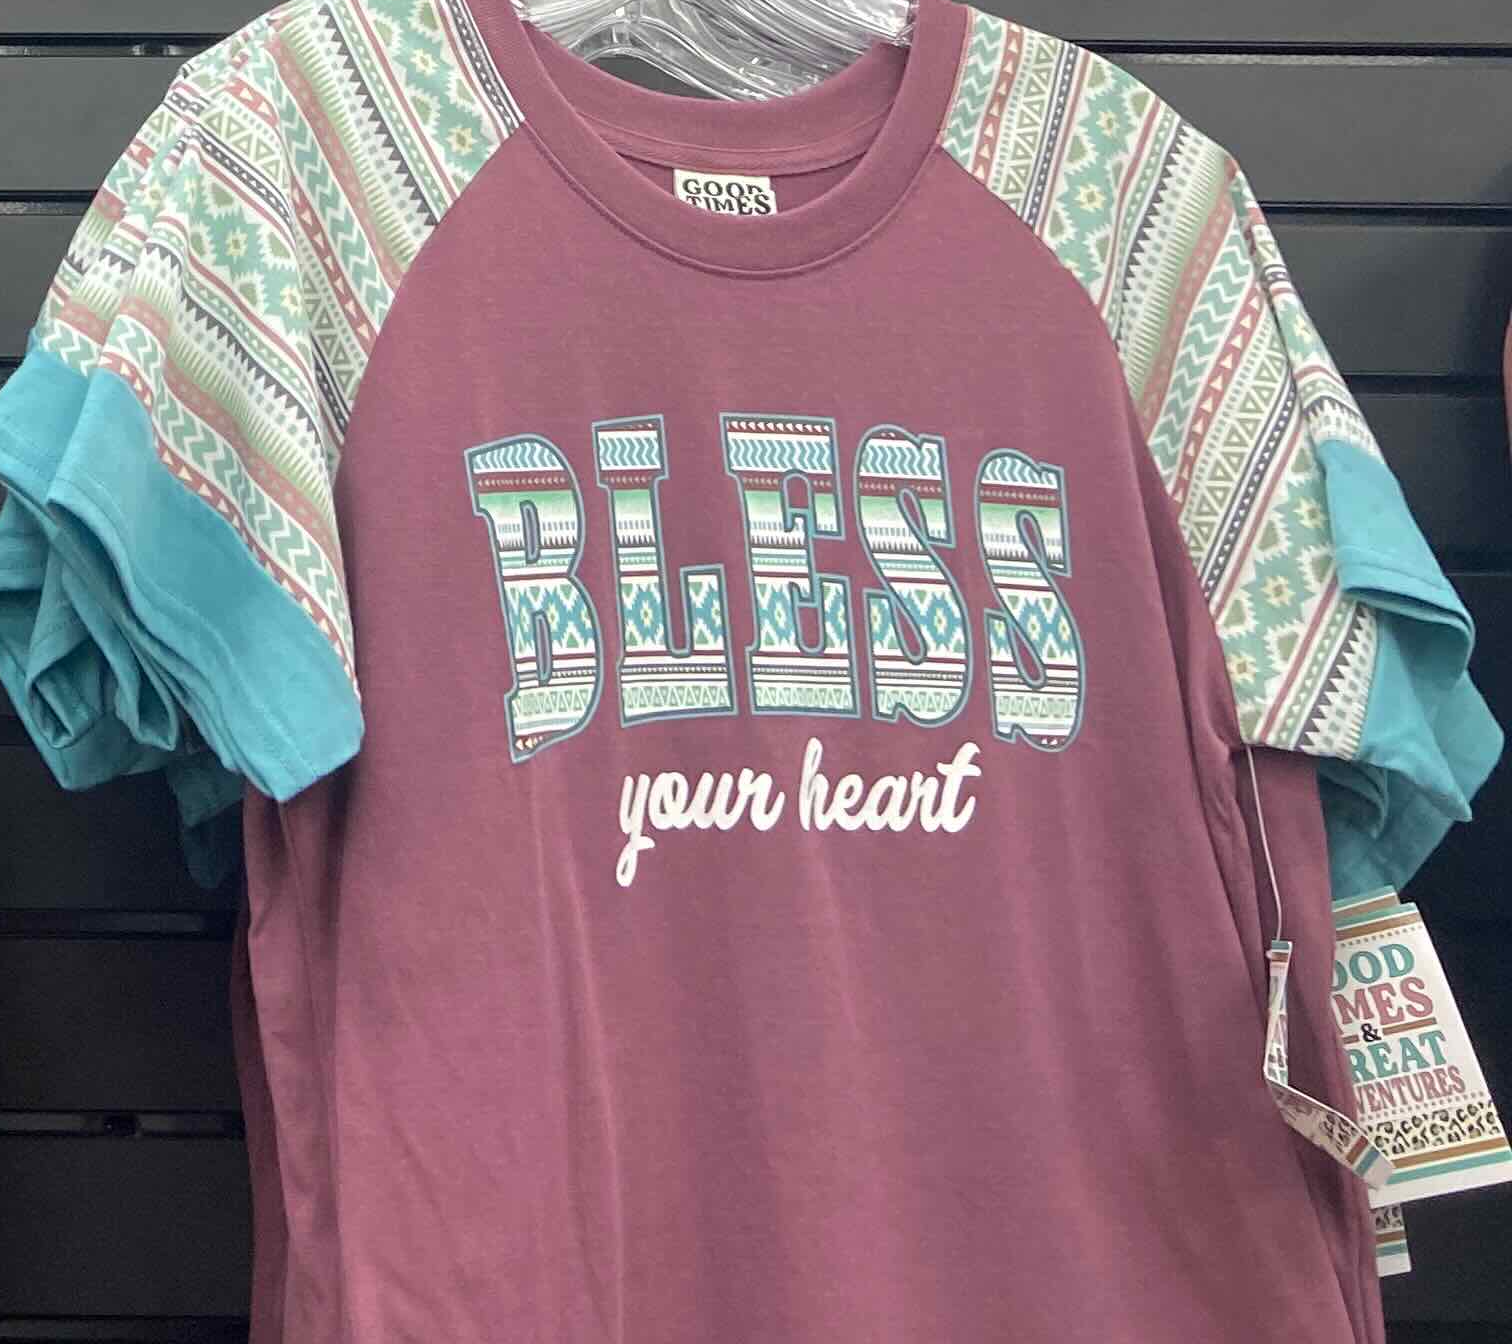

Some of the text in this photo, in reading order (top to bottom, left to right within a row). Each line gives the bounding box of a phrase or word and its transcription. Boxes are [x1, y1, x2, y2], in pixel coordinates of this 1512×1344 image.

[464, 411, 1087, 763] BLESS
[615, 736, 983, 888] your heart
[1331, 943, 1416, 993] OOD
[1333, 976, 1435, 1026] MES
[1346, 1030, 1447, 1083] REAT
[1354, 1064, 1466, 1115] VENTURES
